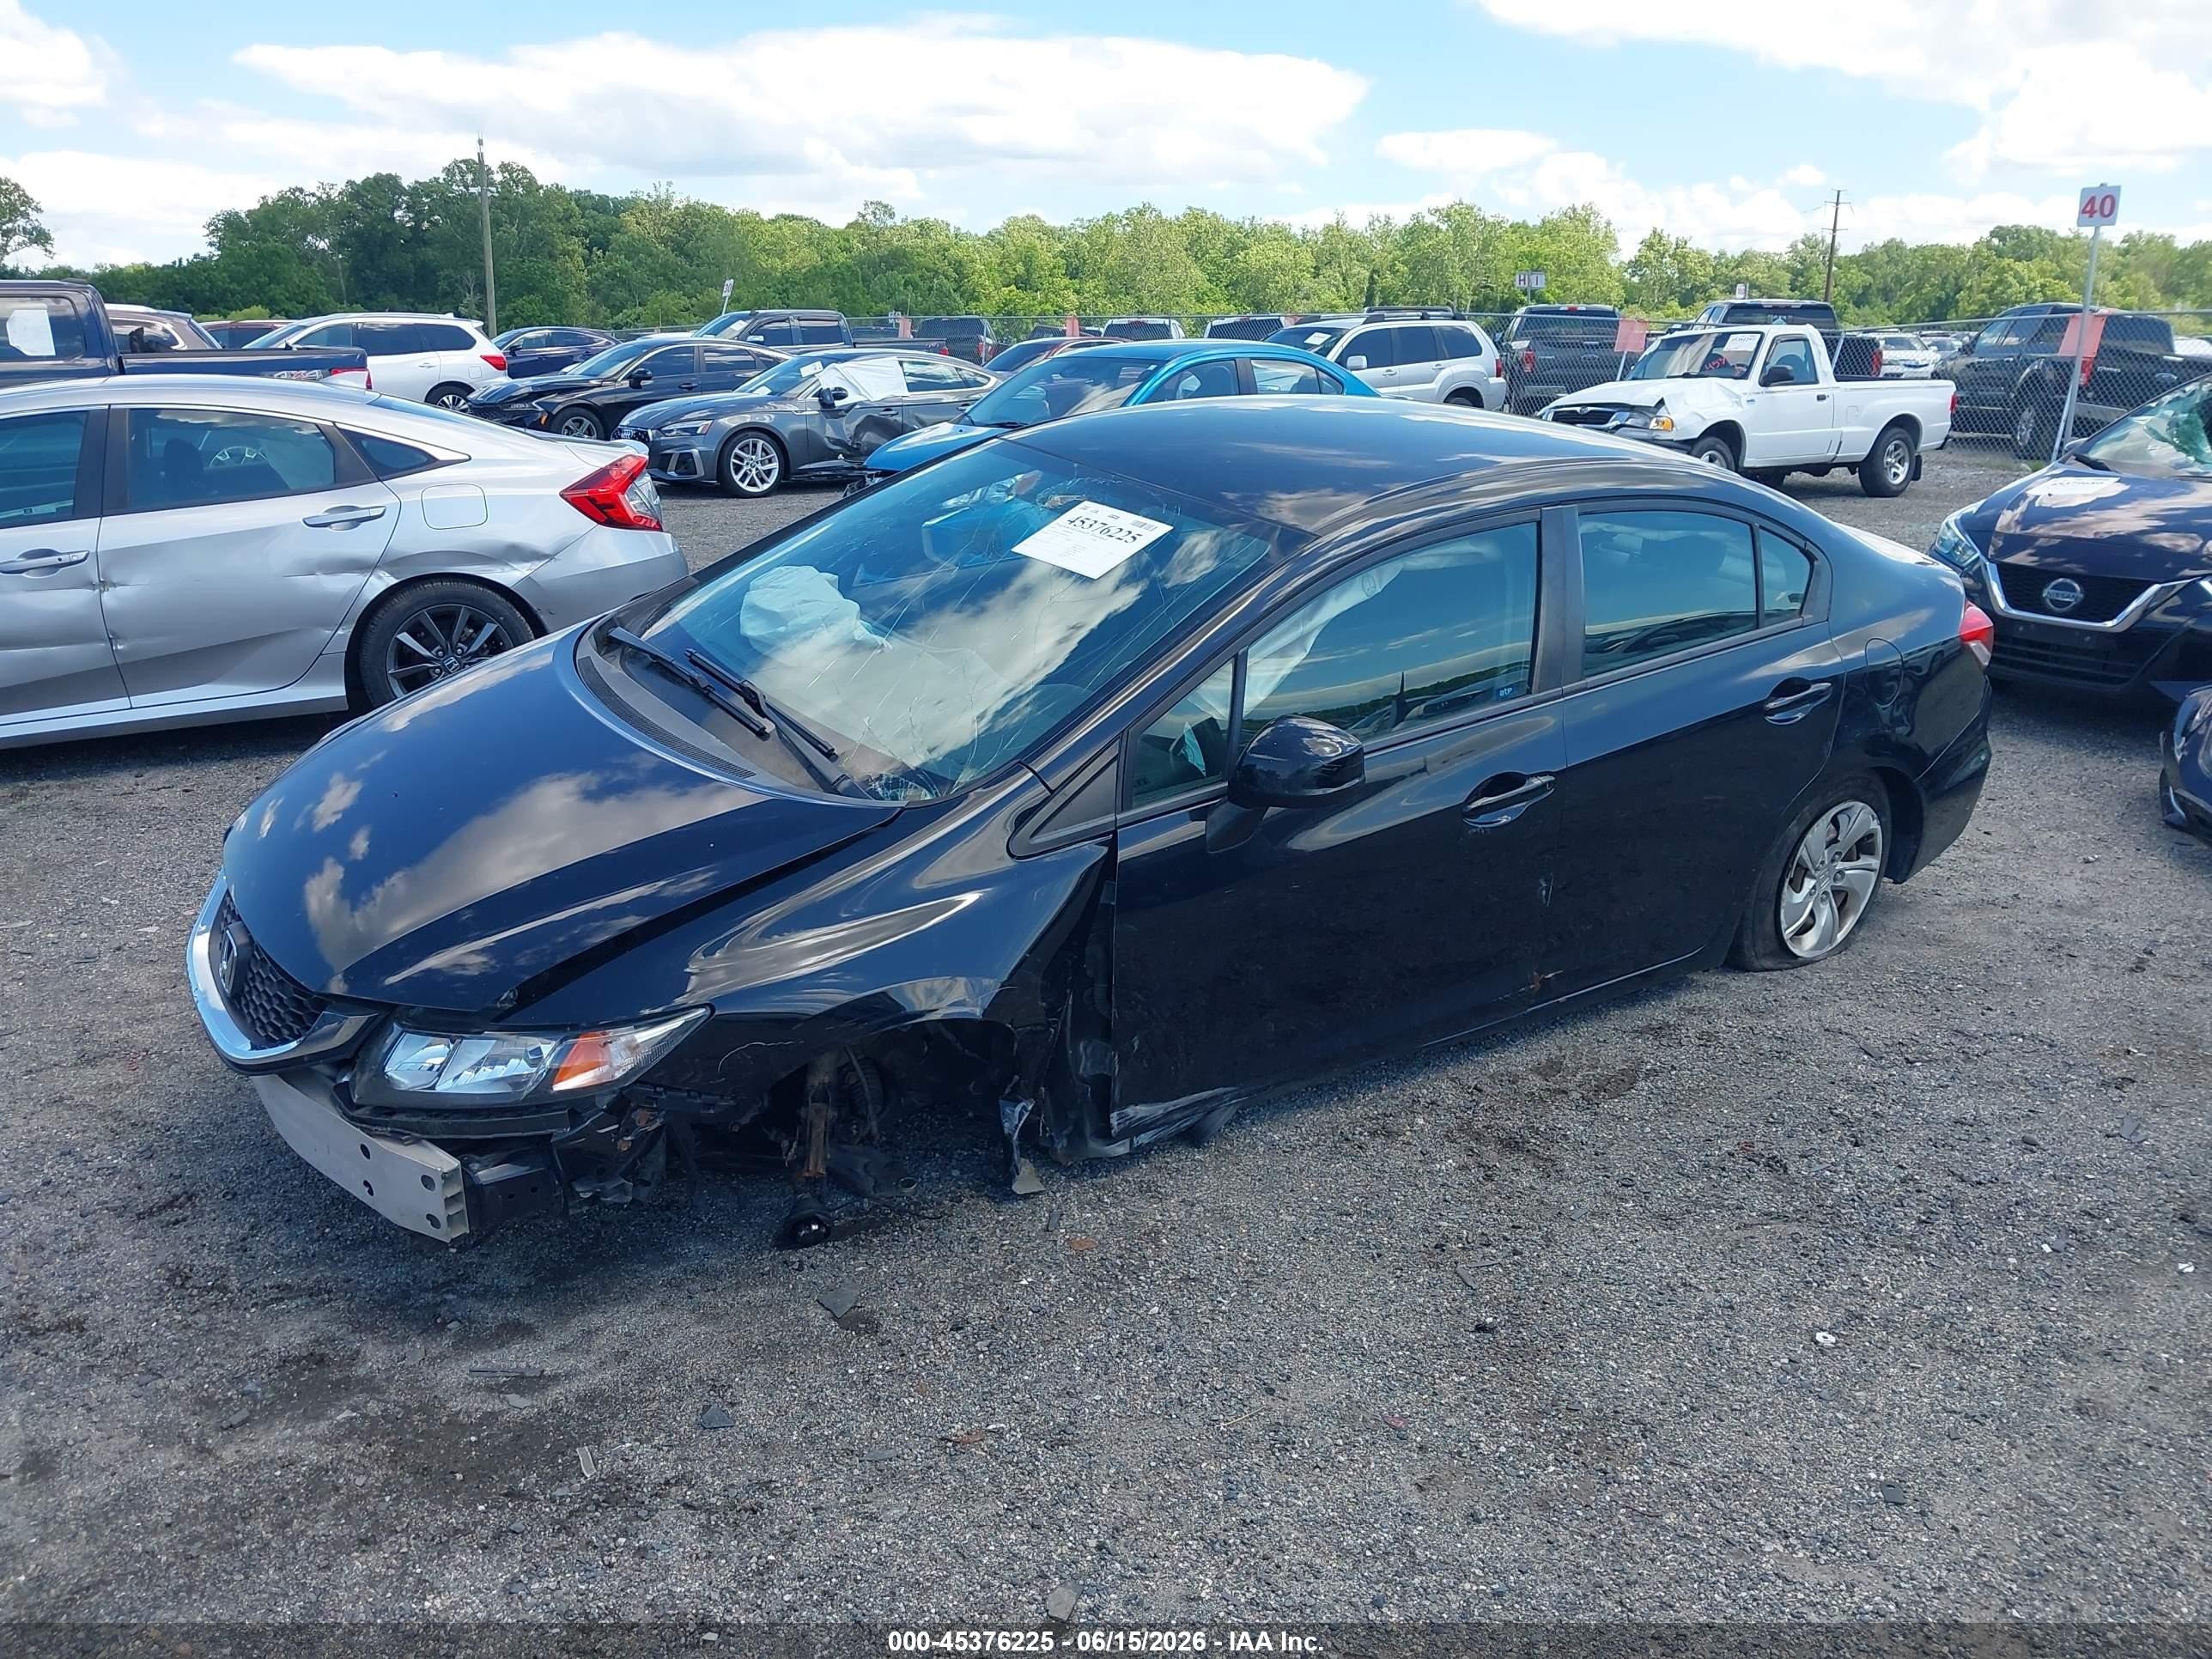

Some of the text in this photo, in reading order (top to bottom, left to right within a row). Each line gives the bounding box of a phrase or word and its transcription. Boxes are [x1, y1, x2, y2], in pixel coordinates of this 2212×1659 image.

[2081, 194, 2116, 218] 40
[1518, 274, 1526, 286] H
[1067, 516, 1143, 543] 45376225
[2045, 590, 2079, 599] NISSAN
